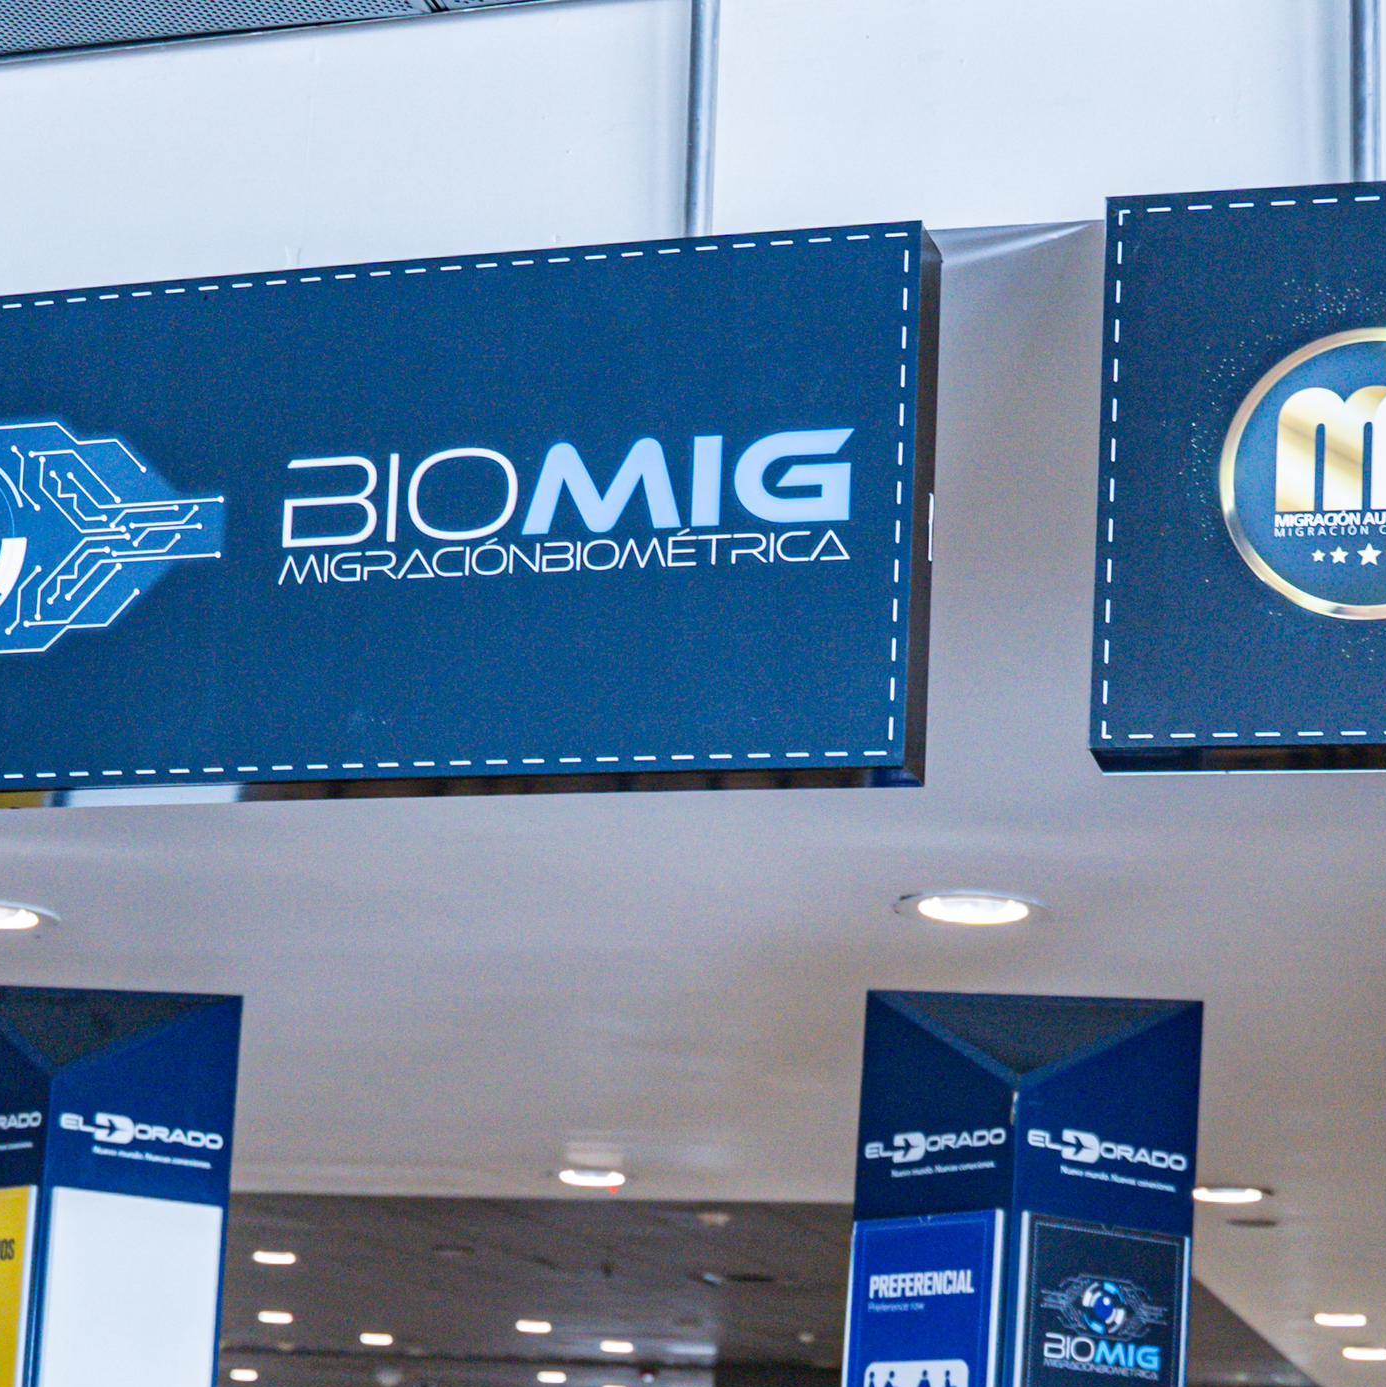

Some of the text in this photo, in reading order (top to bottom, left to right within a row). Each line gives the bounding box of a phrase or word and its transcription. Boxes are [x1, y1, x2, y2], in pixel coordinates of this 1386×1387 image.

[281, 427, 853, 549] BIOMIG
[1273, 524, 1369, 538] MIGRACIÓN
[1274, 509, 1361, 528] MIGRACIÓN
[277, 528, 851, 586] MIGRACIÓNBIOMÉTRICA
[868, 1268, 975, 1299] PREFERENCIAL
[1043, 1332, 1161, 1371] BIOMIG
